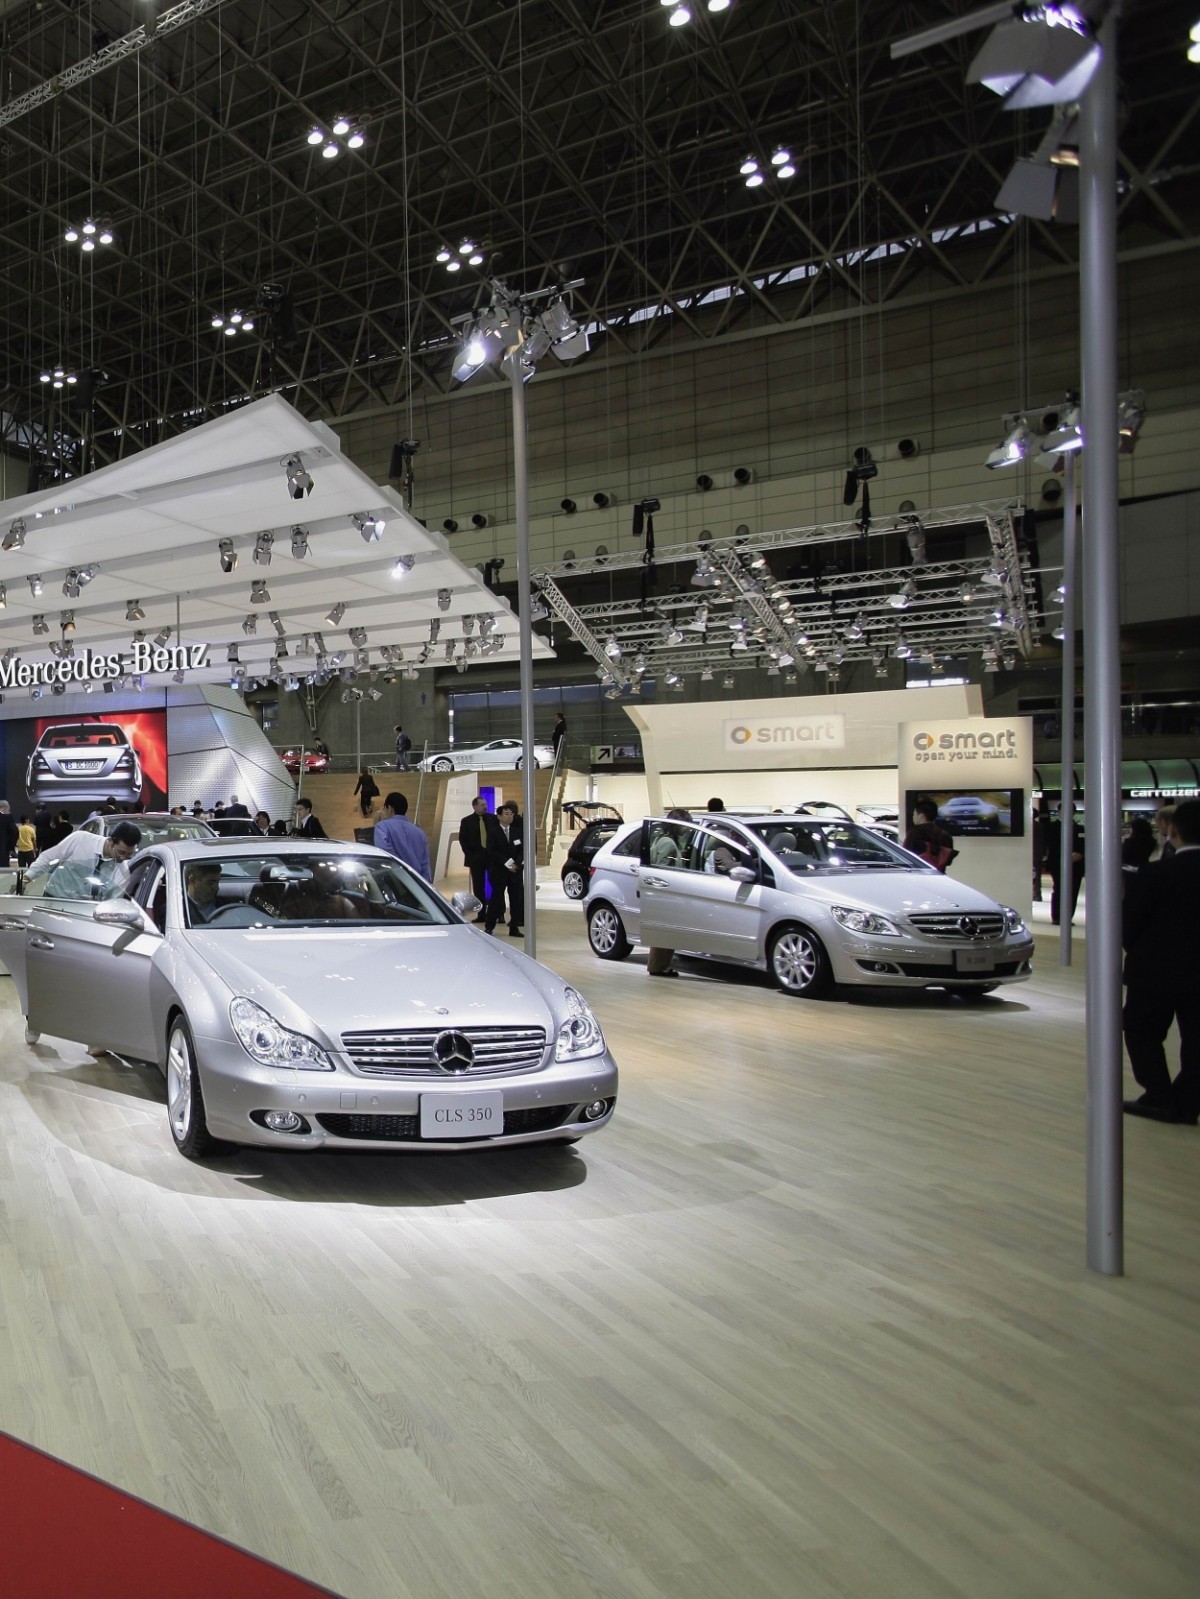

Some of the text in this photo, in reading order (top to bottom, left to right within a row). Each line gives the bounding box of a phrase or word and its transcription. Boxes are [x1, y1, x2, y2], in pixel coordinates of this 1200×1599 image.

[756, 721, 835, 743] smart
[938, 729, 1016, 750] smart
[915, 748, 1018, 763] open your mind.
[434, 1107, 493, 1122] CLS 350
